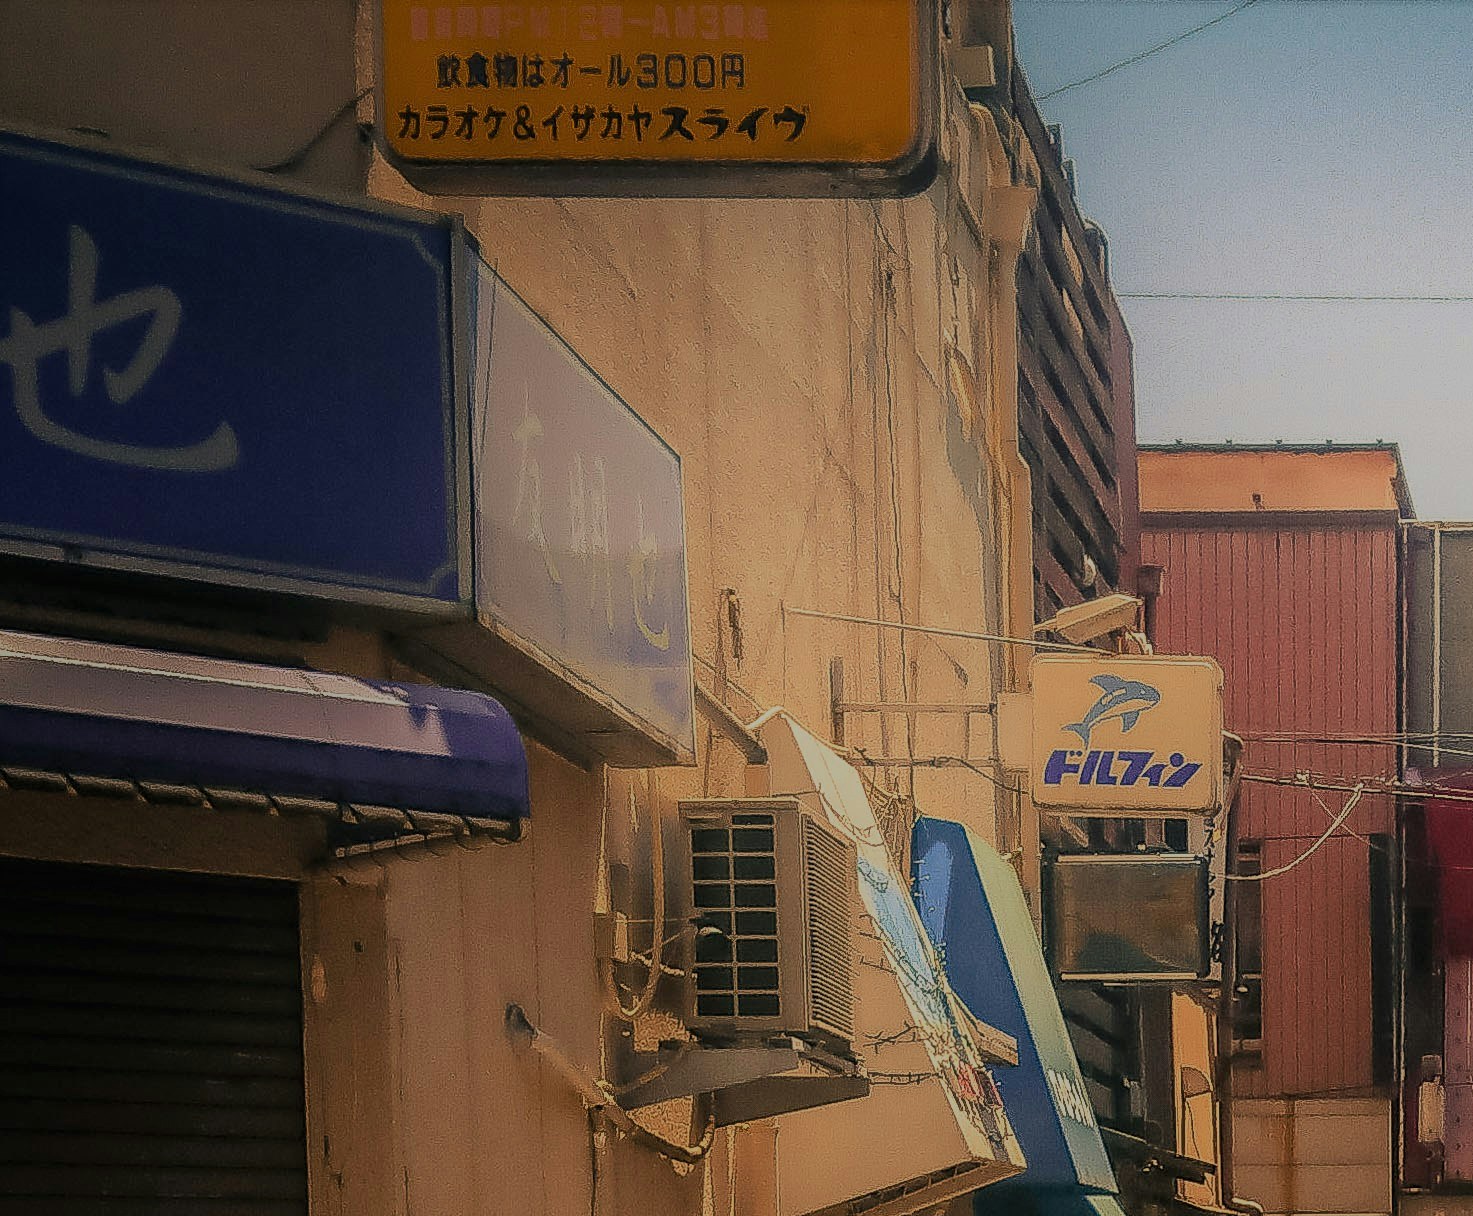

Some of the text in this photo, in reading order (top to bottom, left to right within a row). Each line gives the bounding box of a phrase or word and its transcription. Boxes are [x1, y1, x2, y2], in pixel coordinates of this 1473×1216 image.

[436, 53, 746, 90] 飲食物はオール300円
[1043, 750, 1203, 788] ドルフィン
